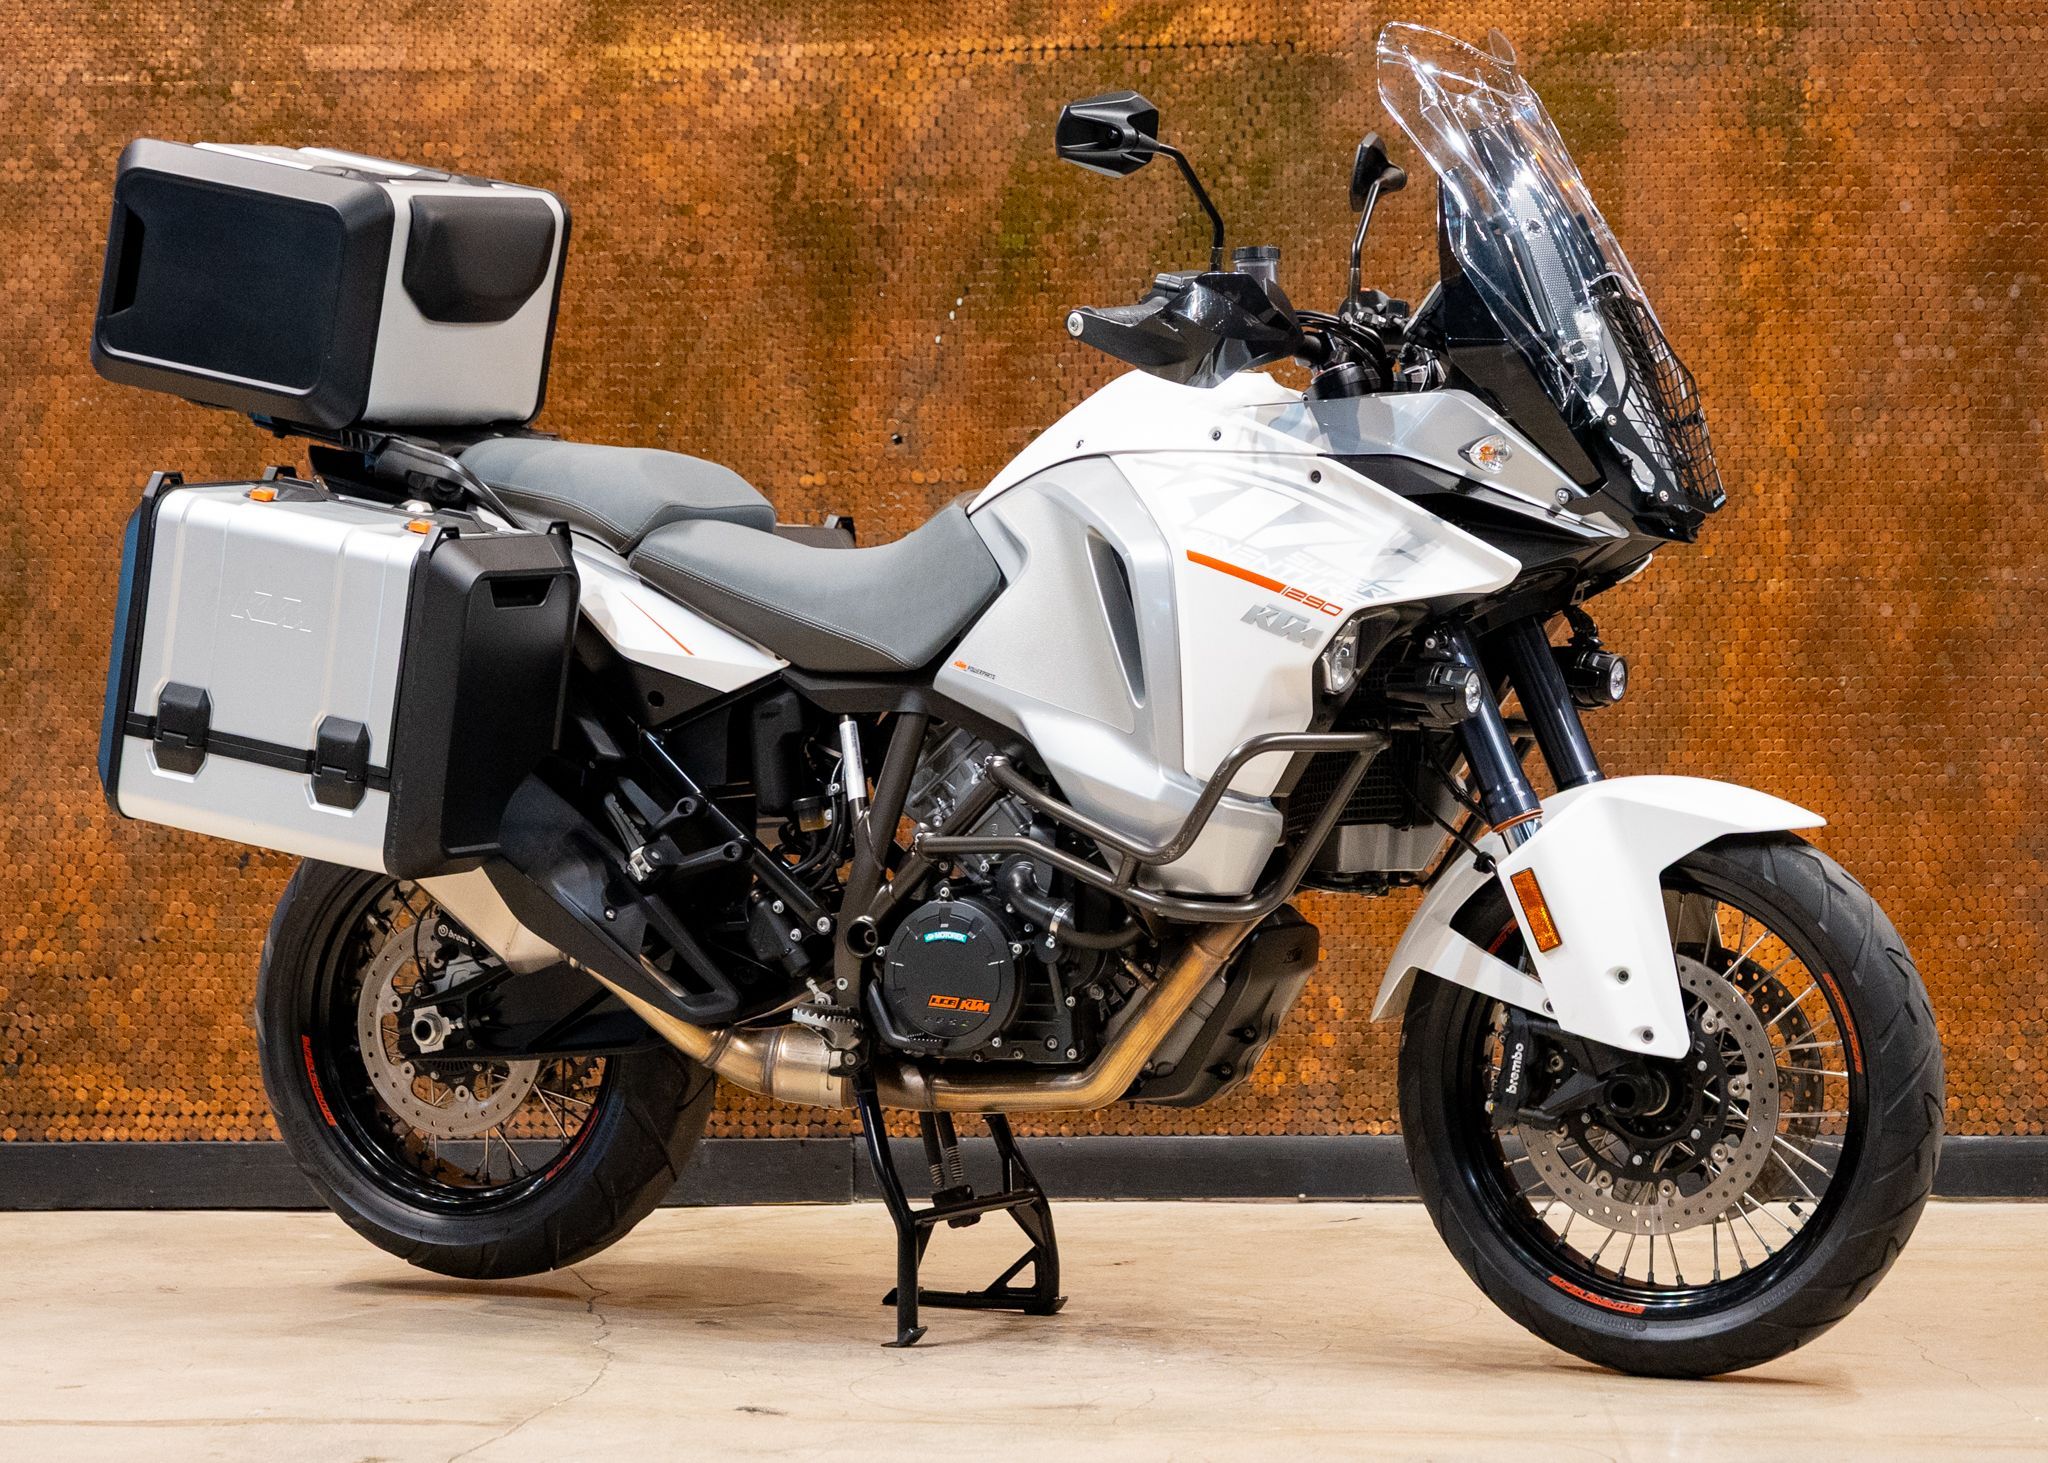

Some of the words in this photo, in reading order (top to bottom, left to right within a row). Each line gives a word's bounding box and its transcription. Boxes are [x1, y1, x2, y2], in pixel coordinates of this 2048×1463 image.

[1281, 585, 1344, 617] 1290
[1240, 603, 1325, 650] KTM
[447, 929, 477, 948] bremo
[959, 998, 991, 1013] KTM
[1505, 1042, 1525, 1095] brembo
